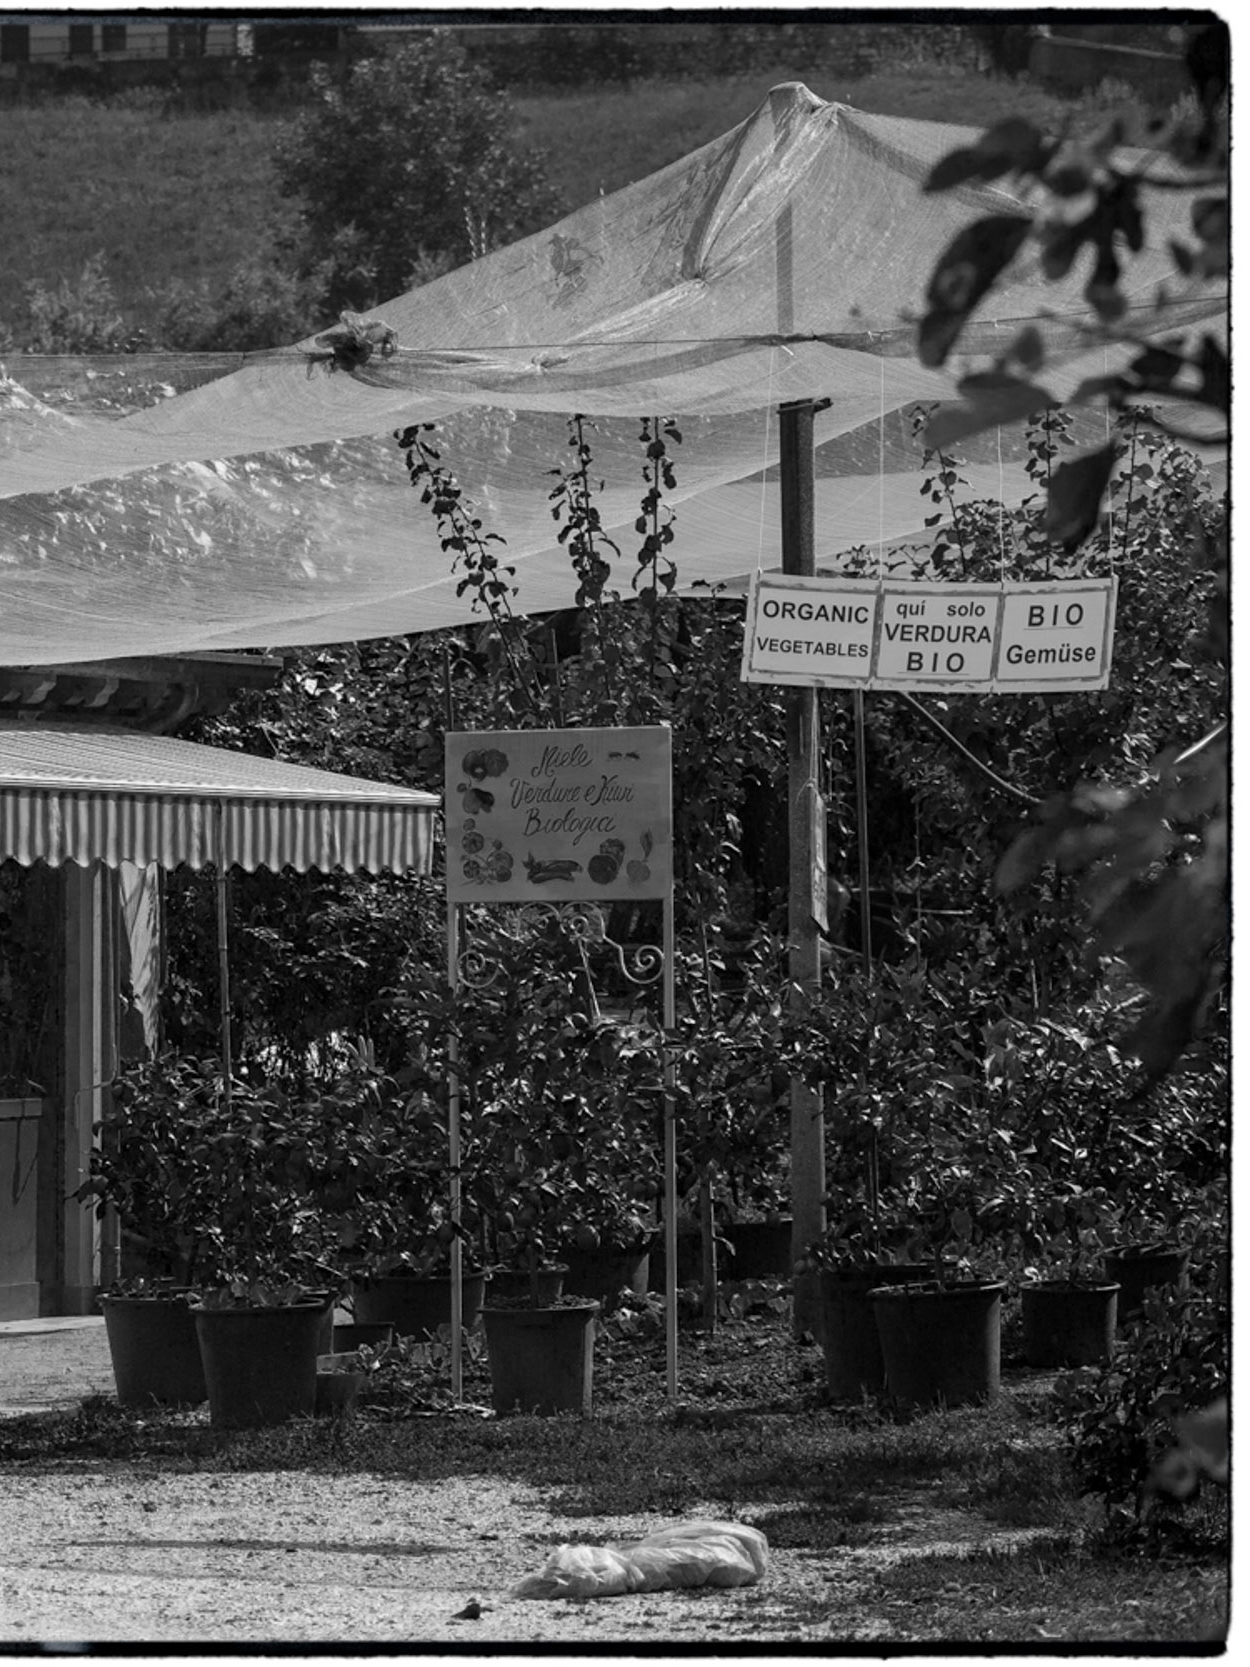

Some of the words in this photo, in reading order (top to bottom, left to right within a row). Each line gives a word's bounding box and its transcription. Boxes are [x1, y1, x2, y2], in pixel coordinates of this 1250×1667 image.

[762, 599, 870, 624] ORGANIC
[946, 601, 986, 617] solo
[1028, 603, 1084, 627] BIO
[884, 623, 992, 644] VERDURA
[756, 636, 869, 658] VEGETABLES
[1006, 643, 1097, 664] Gemüse
[906, 651, 965, 673] BIO
[530, 743, 593, 778] Miele
[509, 777, 582, 810] Verdure
